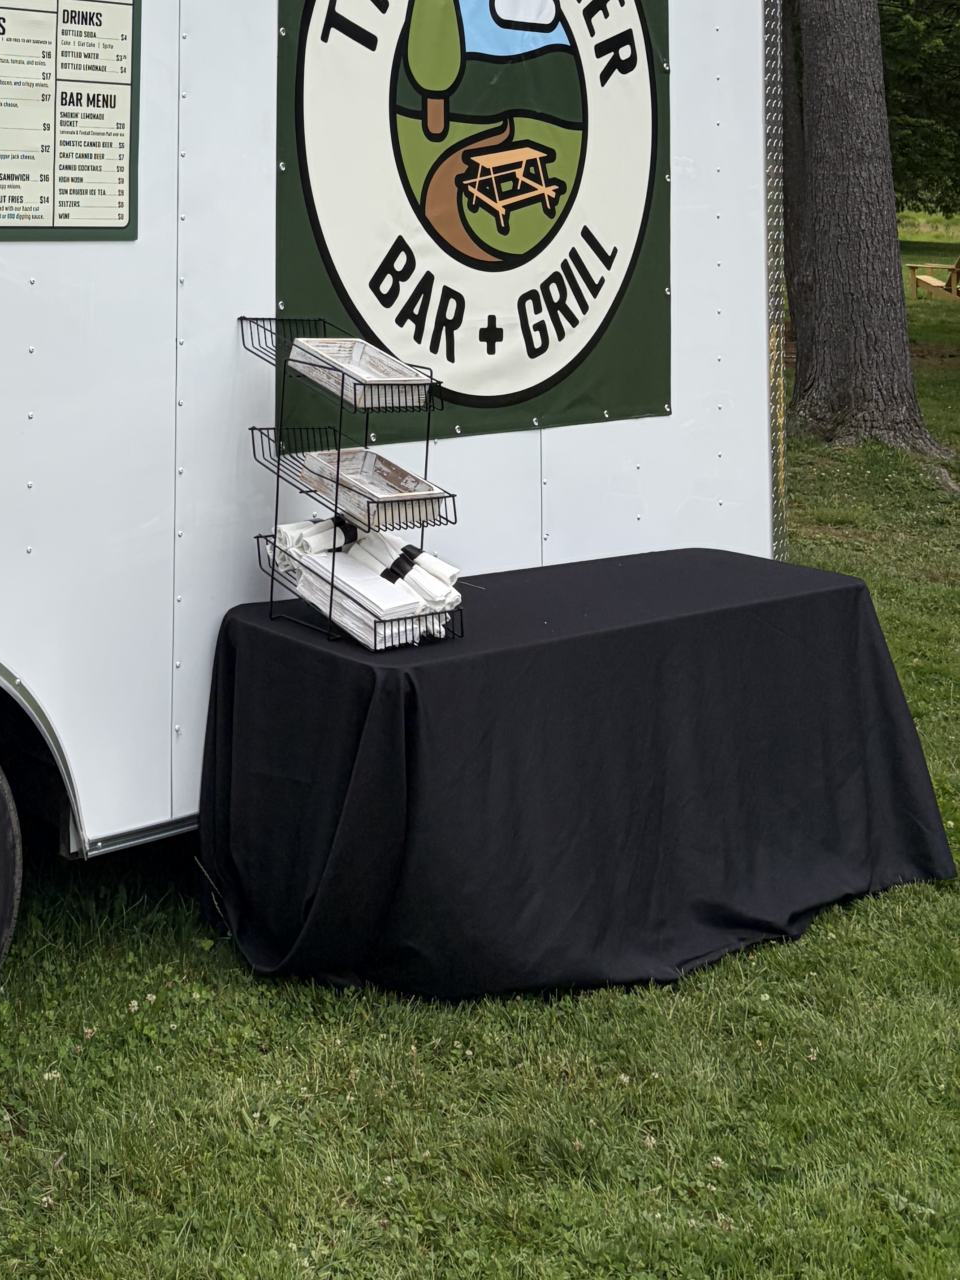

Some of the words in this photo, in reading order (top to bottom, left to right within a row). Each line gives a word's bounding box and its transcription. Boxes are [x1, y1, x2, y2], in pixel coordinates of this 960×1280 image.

[62, 9, 103, 26] DRINKS
[41, 50, 52, 58] $16
[41, 72, 52, 80] $17
[41, 93, 51, 101] $17
[60, 91, 83, 107] BAR
[86, 93, 117, 108] MENU
[40, 144, 51, 152] $12
[39, 174, 50, 182] $16
[7, 195, 24, 203] FRIES
[368, 235, 467, 365] BAR
[516, 224, 619, 360] GRILL
